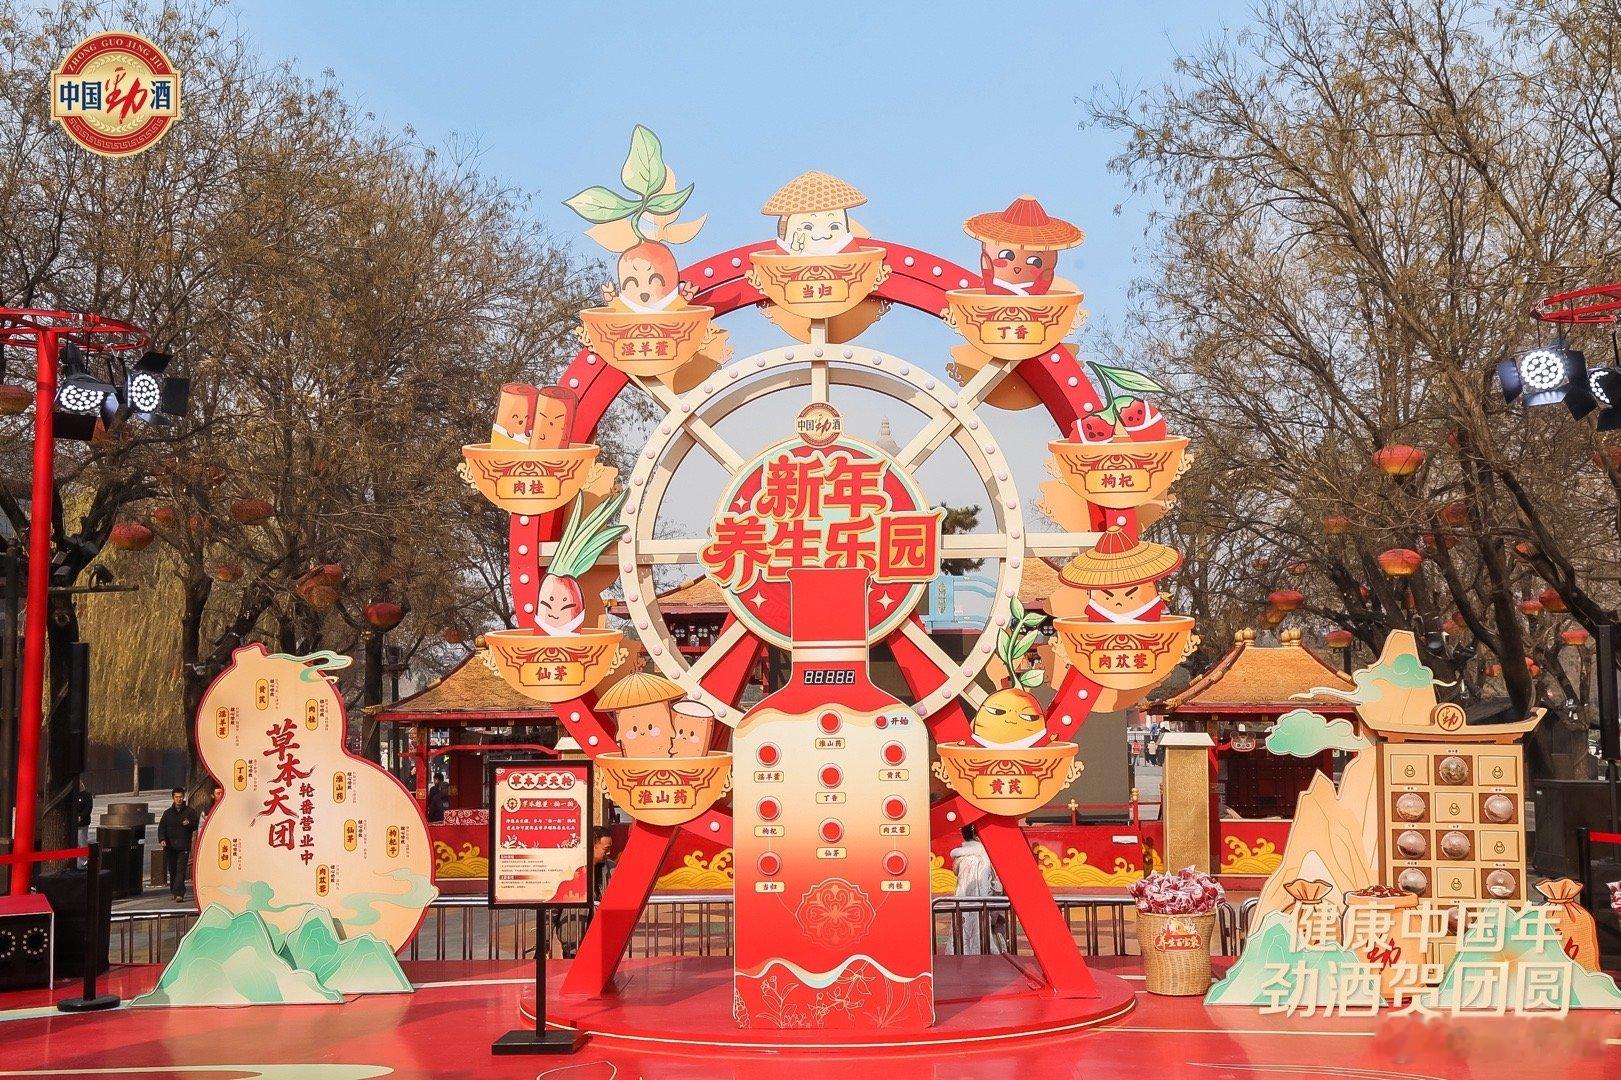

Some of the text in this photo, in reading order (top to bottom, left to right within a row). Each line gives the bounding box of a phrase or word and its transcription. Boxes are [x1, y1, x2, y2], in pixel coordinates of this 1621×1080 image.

[802, 285, 832, 299] 当归
[997, 325, 1029, 340] 丁香
[621, 341, 669, 357] 淫羊藿
[513, 481, 545, 495] 肉桂
[756, 454, 889, 519] 新年
[1101, 473, 1135, 488] 枸杞
[702, 512, 942, 592] 养生乐园
[1098, 654, 1149, 669] 肉苁蓉
[536, 666, 567, 681] 仙茅
[890, 716, 909, 726] 开始
[818, 740, 842, 748] 淮山药
[886, 771, 901, 780] 黄芪
[251, 718, 319, 851] 草本天团
[990, 778, 1022, 794] 黄芪
[639, 789, 687, 805] 淮山药
[823, 794, 838, 802] 丁香
[299, 783, 316, 866] 轮番营业中
[762, 827, 777, 835] 枸杞
[762, 883, 777, 891] 当归
[888, 882, 903, 890] 肉桂
